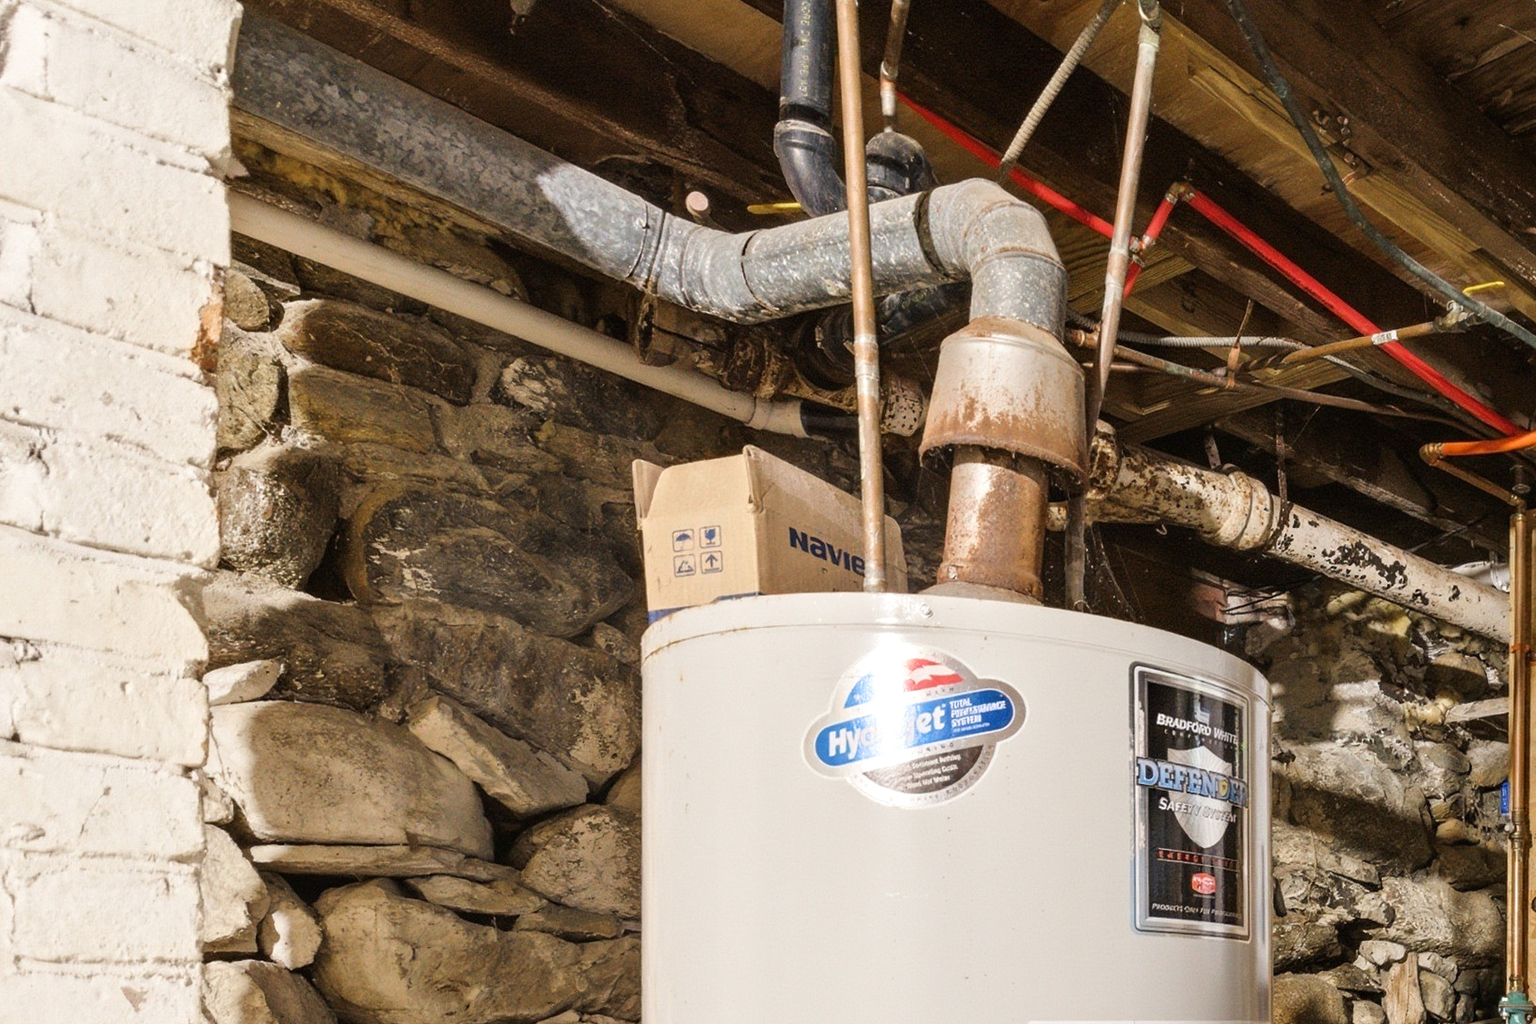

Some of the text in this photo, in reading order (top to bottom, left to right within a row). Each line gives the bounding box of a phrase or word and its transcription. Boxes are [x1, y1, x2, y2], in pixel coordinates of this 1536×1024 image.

[789, 526, 866, 577] Navie
[1156, 713, 1239, 745] BRADFORD WHITE
[1136, 757, 1248, 808] DEFENDER
[1158, 796, 1202, 817] SAFETY
